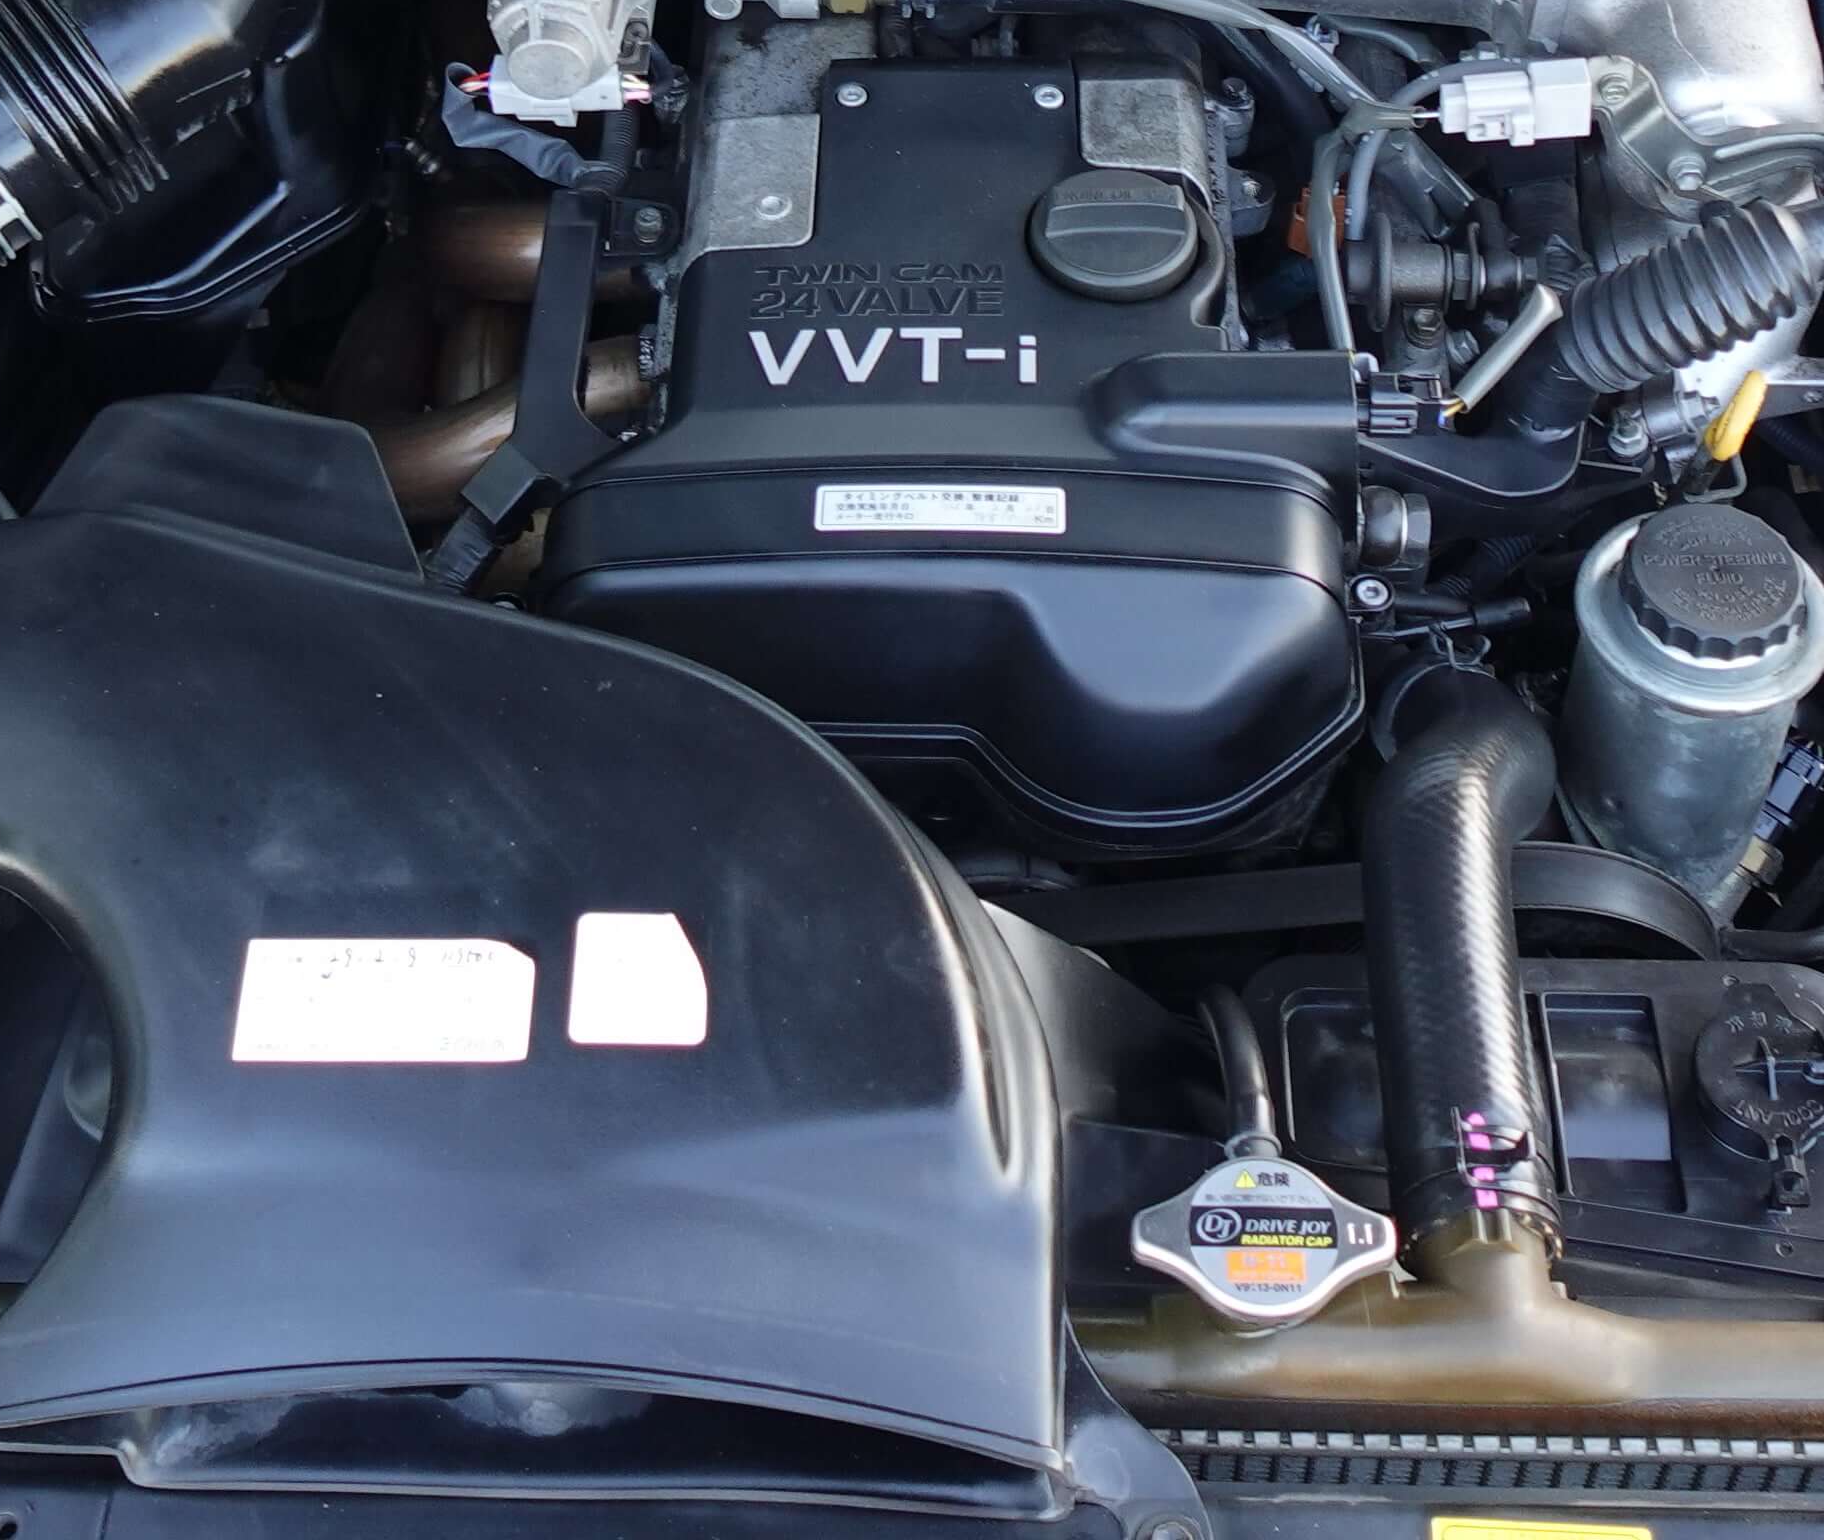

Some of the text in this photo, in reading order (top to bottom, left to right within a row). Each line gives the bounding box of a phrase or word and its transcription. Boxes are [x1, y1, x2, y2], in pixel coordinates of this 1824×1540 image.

[753, 262, 1005, 285] TWIN CAM
[749, 326, 1038, 386] VVT-i
[1642, 552, 1787, 566] POWER STEERING
[1695, 570, 1744, 585] FLUID
[1730, 1098, 1824, 1127] COOLANT
[1257, 1170, 1291, 1188] 危険
[1244, 1219, 1332, 1236] DRIVE JOY
[1346, 1222, 1373, 1245] 1.1
[1240, 1234, 1333, 1248] RADIATOR CAP
